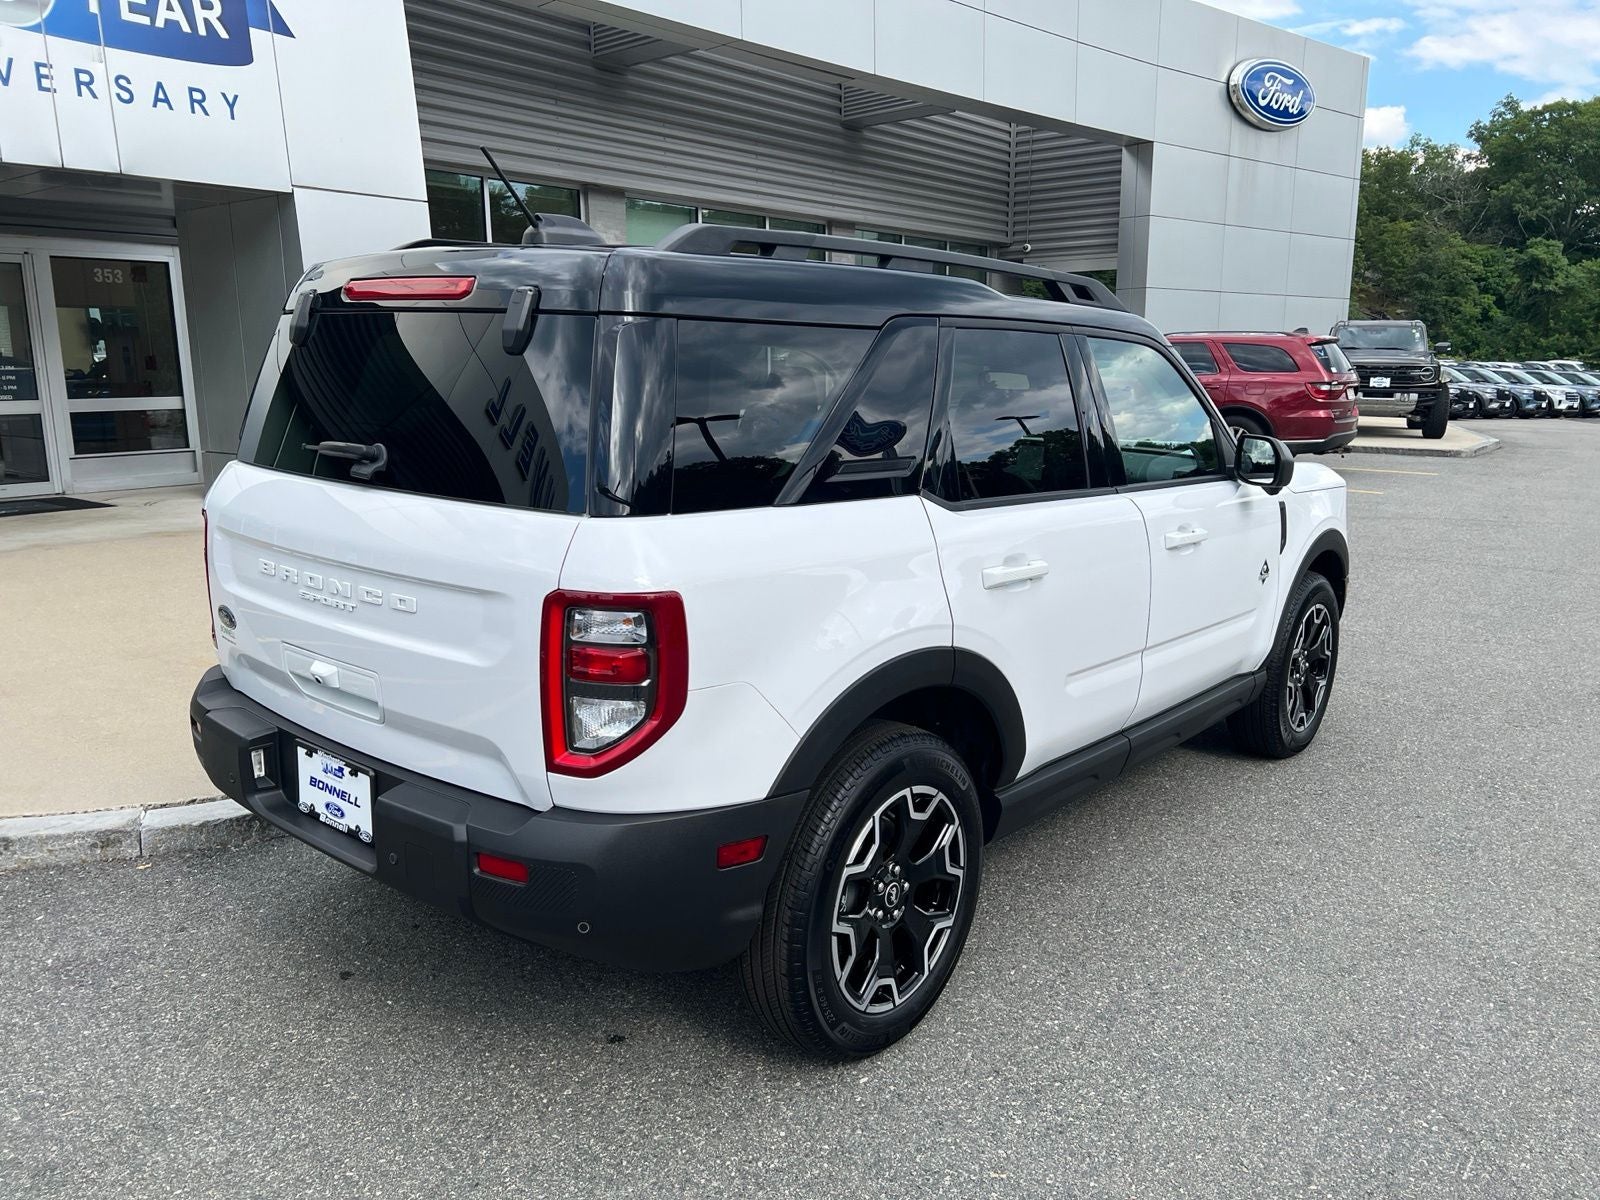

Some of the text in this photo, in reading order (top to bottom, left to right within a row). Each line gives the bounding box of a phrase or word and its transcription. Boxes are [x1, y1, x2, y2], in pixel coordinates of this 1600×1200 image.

[89, 0, 230, 40] EAR
[1258, 72, 1304, 115] Ford
[93, 268, 123, 283] 353
[258, 558, 418, 614] BRONCO
[299, 589, 357, 612] SPORT
[309, 775, 361, 809] BONNELL
[320, 812, 348, 833] Bonnell
